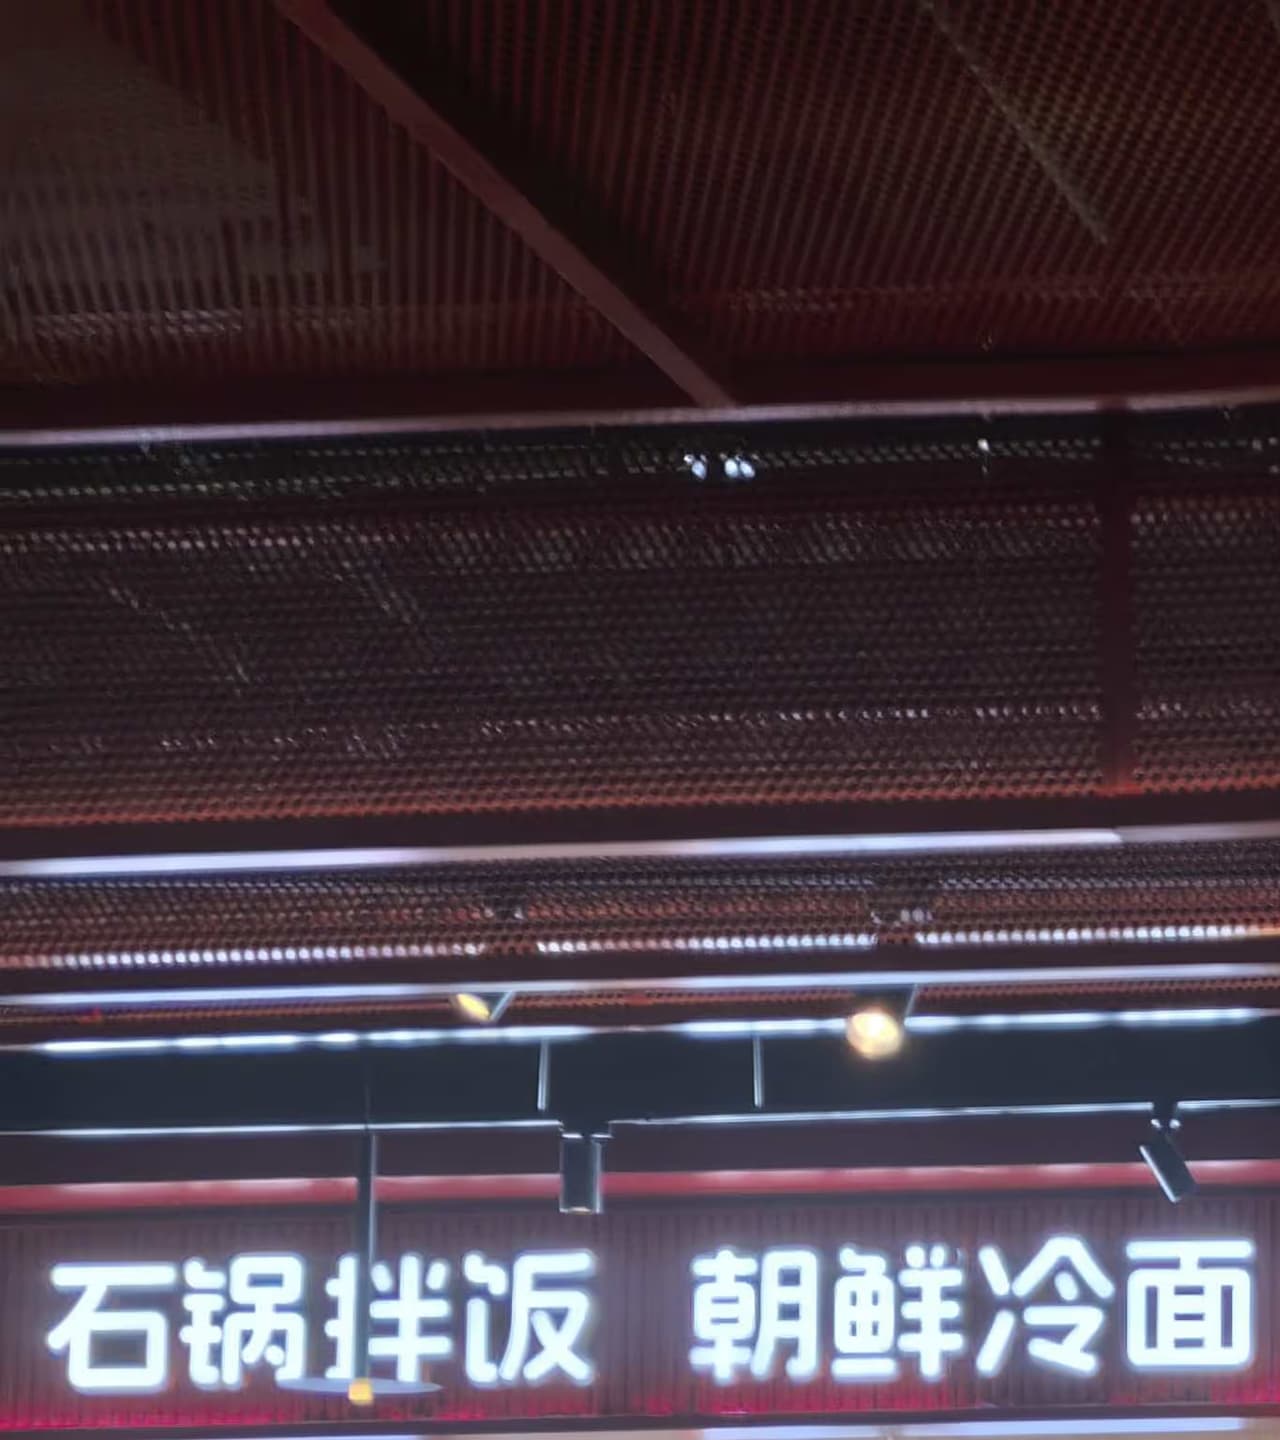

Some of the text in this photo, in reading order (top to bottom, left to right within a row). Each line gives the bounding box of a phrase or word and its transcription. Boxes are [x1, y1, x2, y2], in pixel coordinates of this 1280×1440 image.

[47, 1249, 595, 1392] 石锅拌饭
[690, 1236, 1255, 1380] 朝鲜冷面
